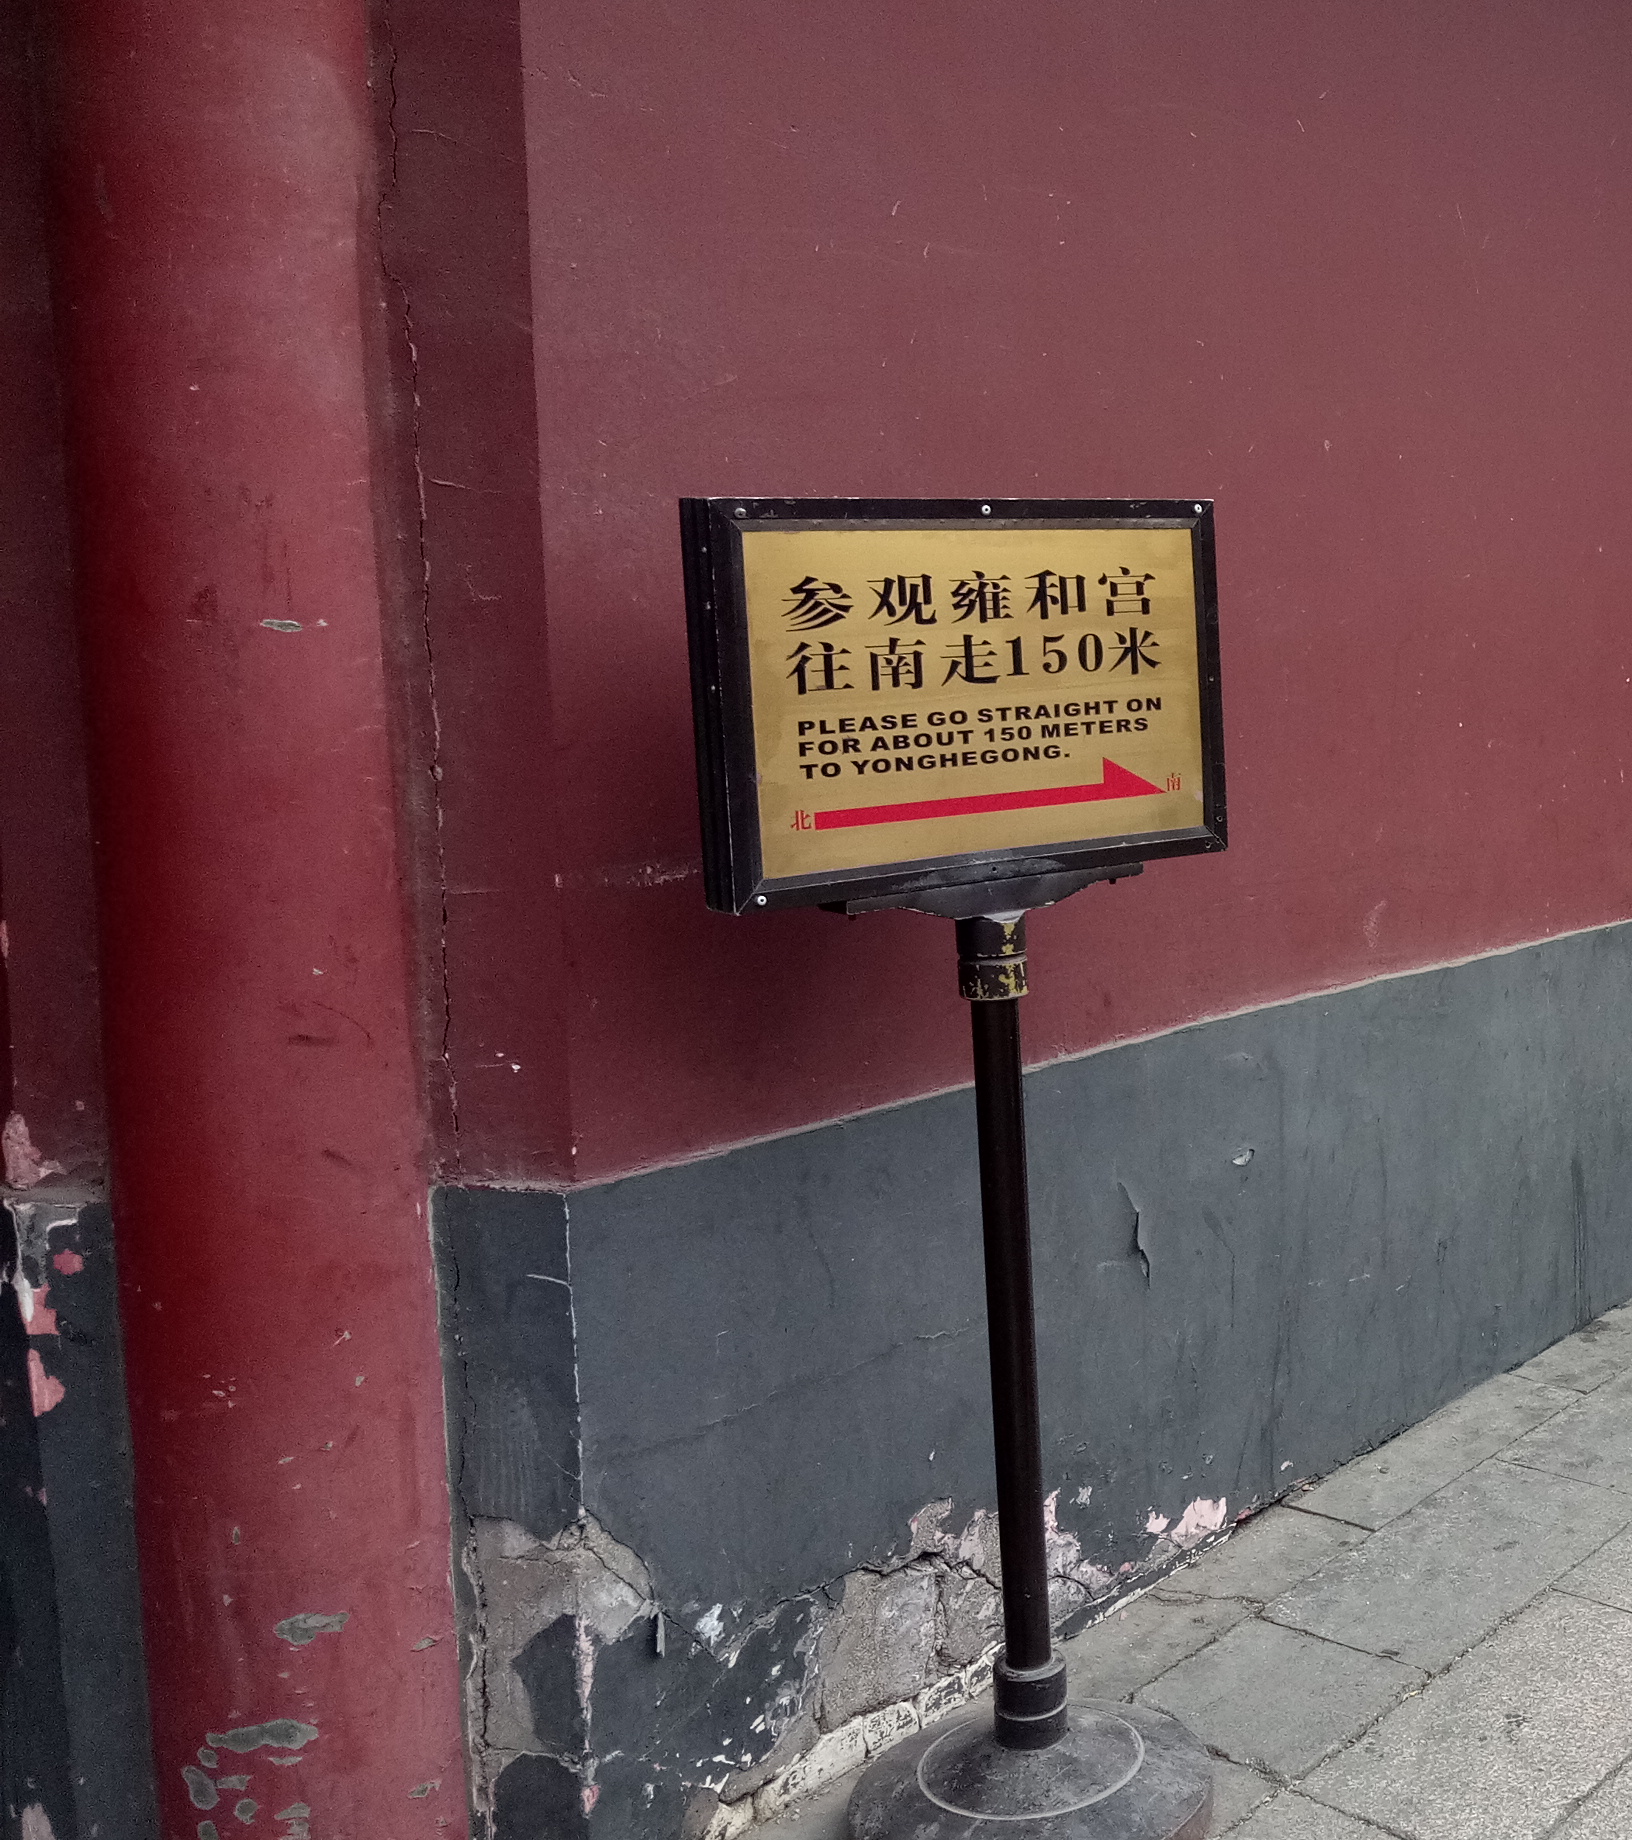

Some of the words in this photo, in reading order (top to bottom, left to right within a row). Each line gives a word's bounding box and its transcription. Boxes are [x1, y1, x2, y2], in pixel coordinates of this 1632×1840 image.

[781, 567, 1156, 632] 参观雍和宫
[785, 627, 1162, 695] 往南走150米
[797, 713, 918, 736] PLEASE
[927, 710, 968, 727] GO
[977, 699, 1119, 723] STRAIGHT
[1126, 697, 1162, 712] ON
[799, 738, 861, 757] FOR
[870, 729, 974, 752] ABOUT
[983, 725, 1032, 743] 150
[1040, 717, 1149, 739] METERS
[800, 763, 841, 780] TO
[851, 744, 1071, 775] YONGHEGONG.
[1166, 772, 1182, 792] 南
[790, 810, 812, 831] 北
